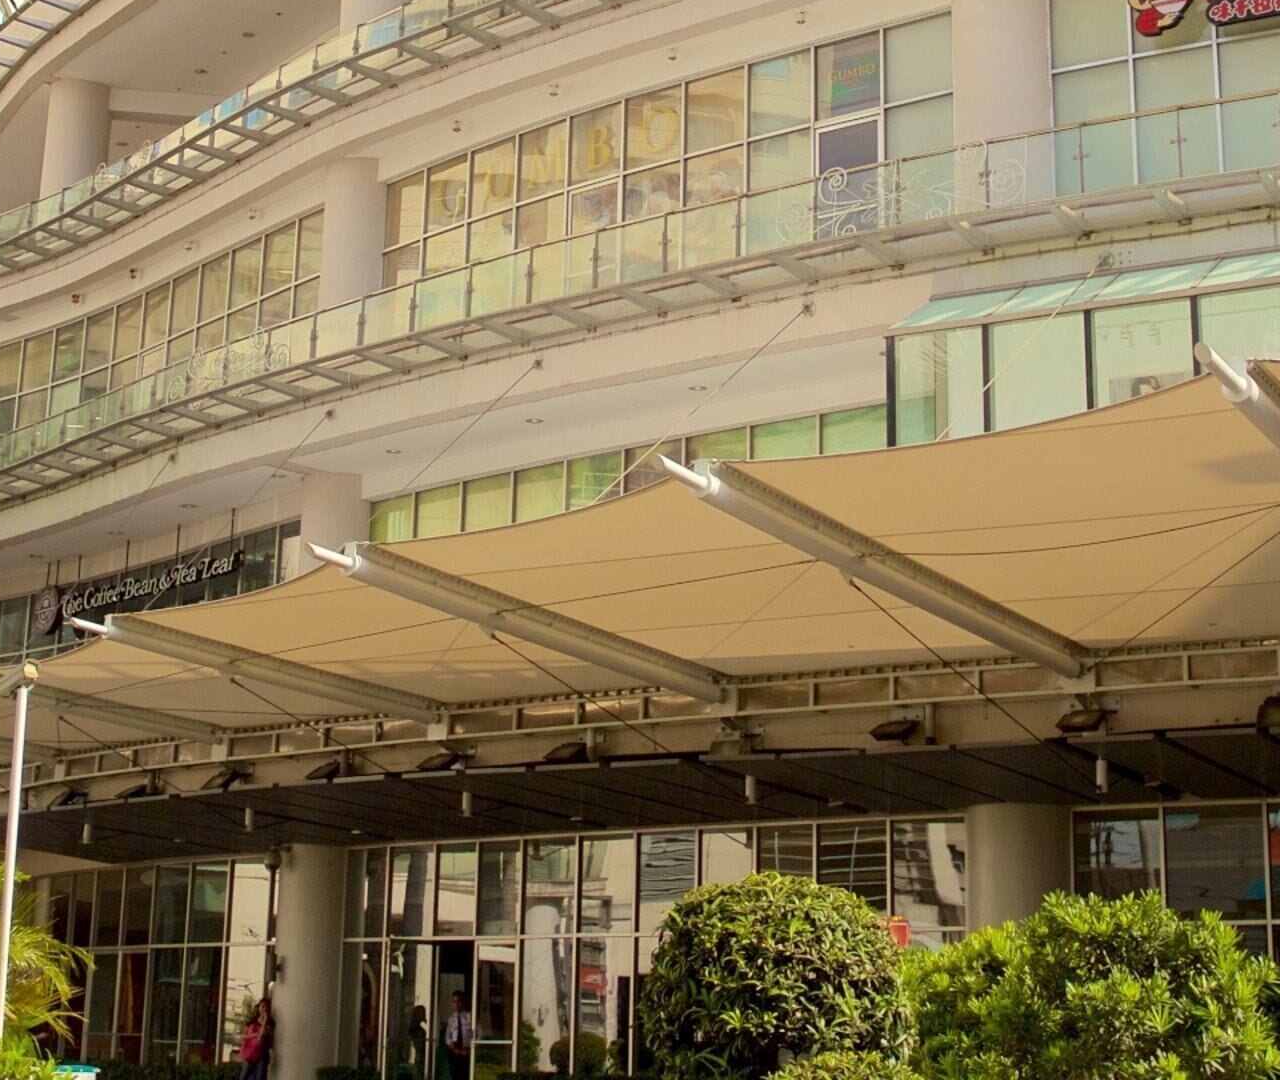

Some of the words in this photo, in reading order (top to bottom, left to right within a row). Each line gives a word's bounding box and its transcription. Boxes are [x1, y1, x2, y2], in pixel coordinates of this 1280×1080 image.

[827, 62, 876, 83] GUMBO
[431, 105, 680, 217] GUMBO
[83, 584, 121, 610] Coffee
[121, 577, 159, 600] Bean
[159, 568, 173, 590] &
[170, 563, 197, 586] Tea
[199, 549, 238, 579] Leaf
